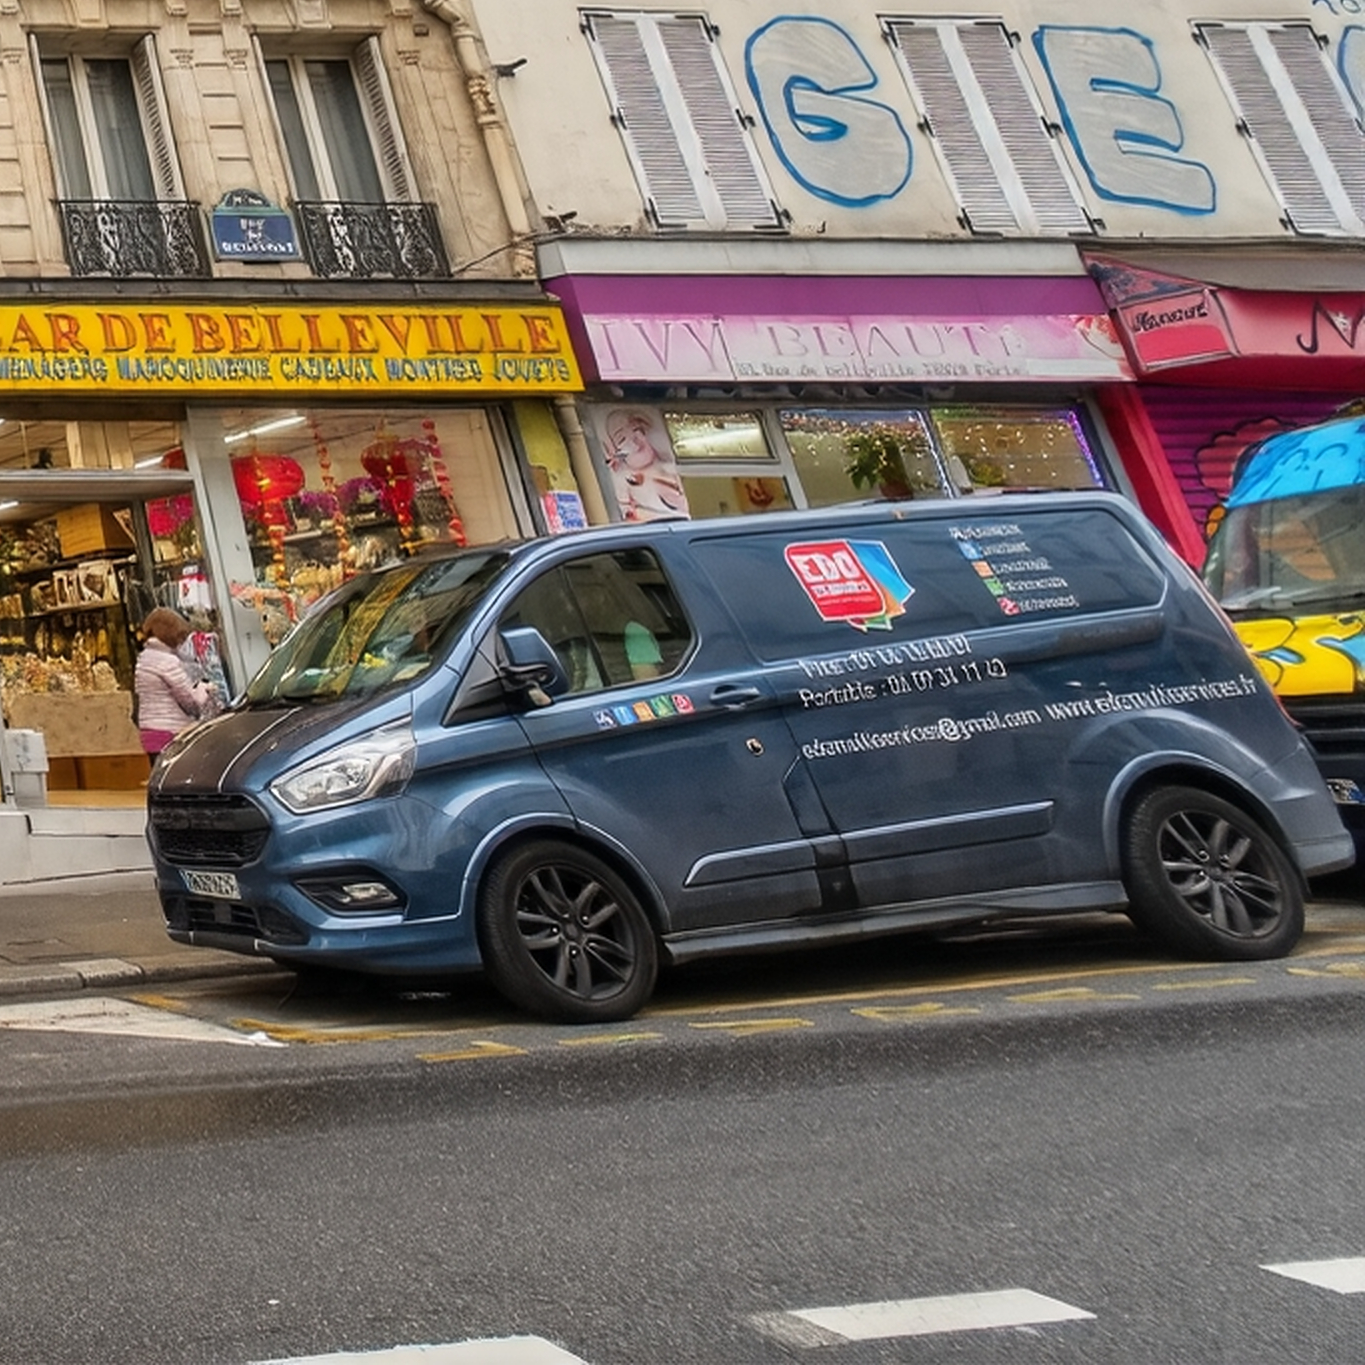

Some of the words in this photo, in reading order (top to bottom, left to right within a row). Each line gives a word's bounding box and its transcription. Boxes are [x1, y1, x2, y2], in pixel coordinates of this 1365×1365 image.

[97, 312, 176, 354] DE
[186, 310, 563, 355] BELLEVILLE
[597, 321, 721, 371] IVY
